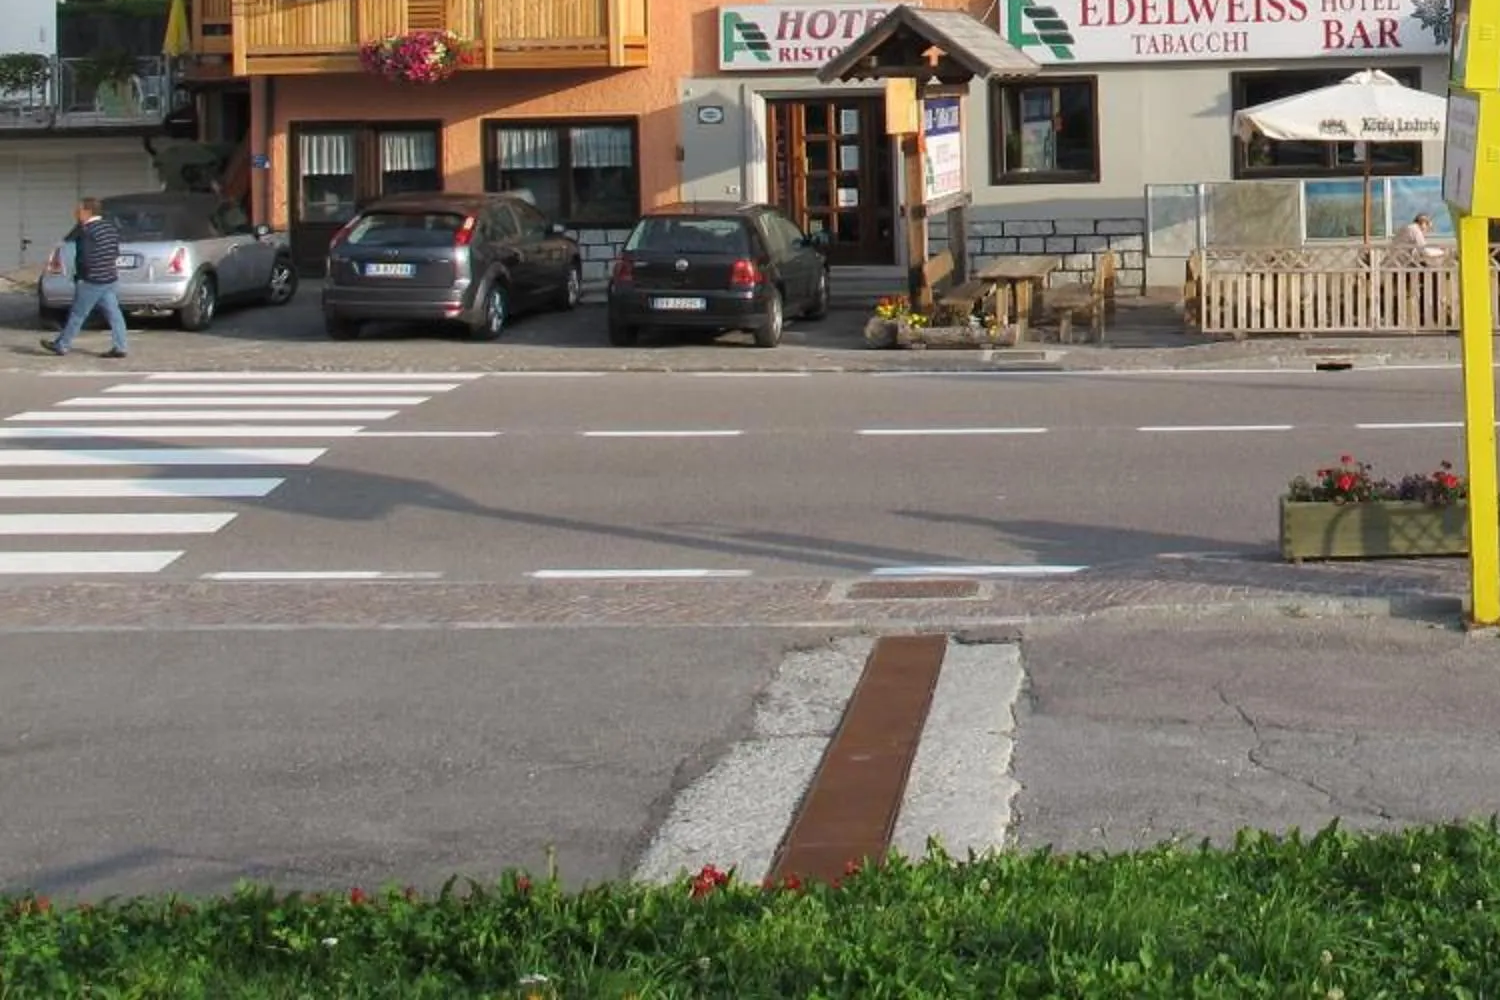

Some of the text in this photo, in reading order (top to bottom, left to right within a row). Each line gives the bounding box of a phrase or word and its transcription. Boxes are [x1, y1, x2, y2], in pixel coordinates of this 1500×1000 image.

[775, 8, 888, 41] HOTE
[1322, 17, 1403, 49] BAR
[1131, 31, 1249, 56] TABACCHI
